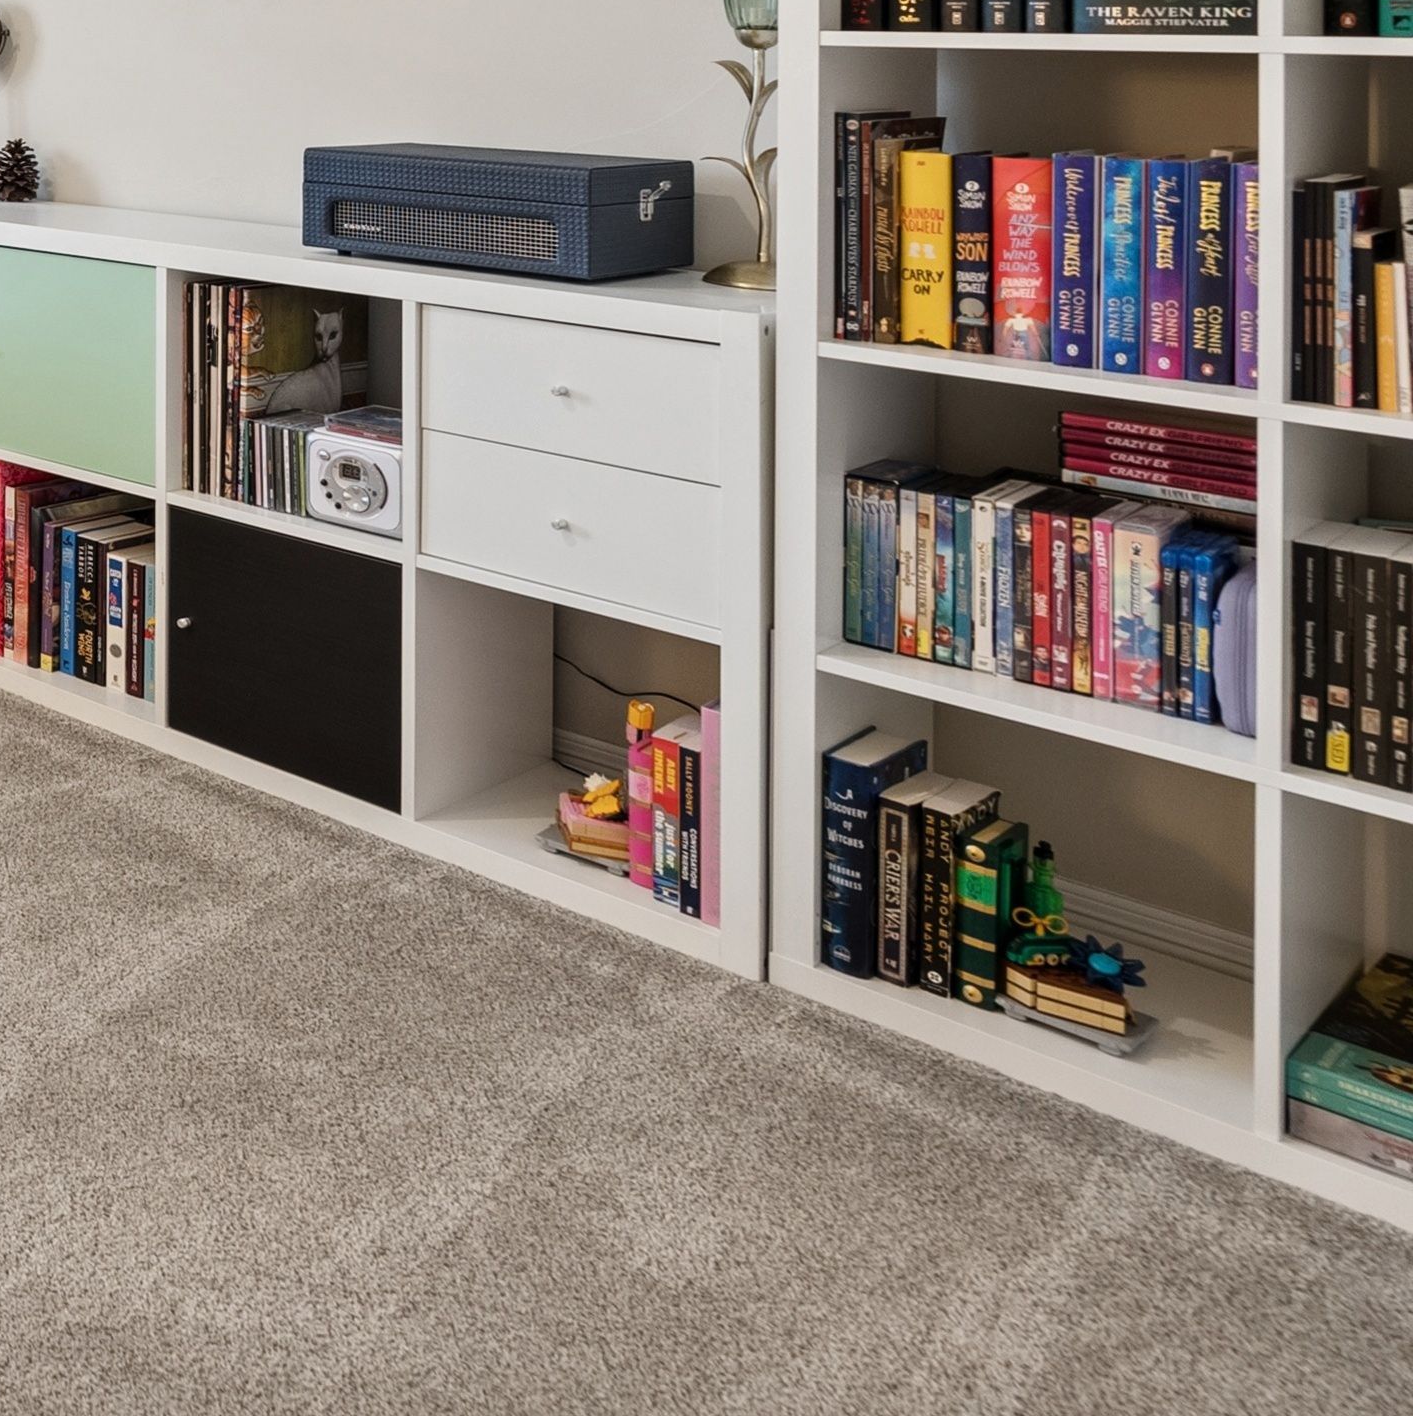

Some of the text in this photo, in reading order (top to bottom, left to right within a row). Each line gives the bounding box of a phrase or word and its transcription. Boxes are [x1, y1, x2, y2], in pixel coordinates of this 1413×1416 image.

[1085, 6, 1252, 18] THE RAVEN KING
[1104, 18, 1230, 27] MAGGIE STIEFVATER
[957, 189, 986, 201] SIMON
[1006, 191, 1036, 204] SIMON
[1113, 176, 1132, 226] PRINCESS
[901, 207, 945, 221] RAINBOW
[1199, 180, 1222, 232] PRINCESS
[847, 144, 860, 306] NEIL GAIMAN STARDUST
[901, 220, 944, 234] ROWELL
[1009, 213, 1037, 225] ANY
[1009, 225, 1037, 237] WAY
[956, 242, 987, 261] SON
[1010, 238, 1032, 249] THE
[1155, 224, 1175, 270] PRINCESS
[1003, 250, 1037, 261] WIND
[1063, 232, 1081, 278] PRINCESS
[901, 268, 944, 282] CARRY
[956, 271, 989, 282] RAINBOW
[998, 261, 1040, 273] BLOWS
[913, 285, 930, 295] ON
[957, 282, 986, 294] ROWELL
[1001, 276, 1042, 288] RAINBOW
[1001, 287, 1036, 298] ROWELL
[1059, 287, 1086, 334] CONNIE GLYNN
[1107, 295, 1135, 343] CONNIE GLYNN
[1151, 299, 1179, 348] CONNIE GLYNN
[1193, 305, 1222, 354] CONNIE GLYNN
[1240, 310, 1254, 353] GLYNN
[1106, 420, 1167, 438] CRAZY EX
[1104, 436, 1166, 453] CRAZY EX
[1109, 452, 1171, 470] CRAZY EX
[1108, 466, 1169, 483] CRAZY EX
[86, 544, 94, 584] REBECCA
[666, 757, 676, 792] ABBY
[685, 755, 694, 817] SALLY ROONEY
[824, 796, 868, 820] DISCOVERY
[842, 820, 854, 832] OF
[653, 810, 665, 876] the summer
[826, 827, 865, 849] WITCHES
[925, 814, 935, 859] WEIR
[939, 819, 951, 864] ANDY
[689, 828, 698, 889] CONVERSATIONS
[884, 849, 902, 941] CRIER'S WAR
[923, 873, 934, 963] HAIL MARY
[939, 883, 950, 962] PROJECT
